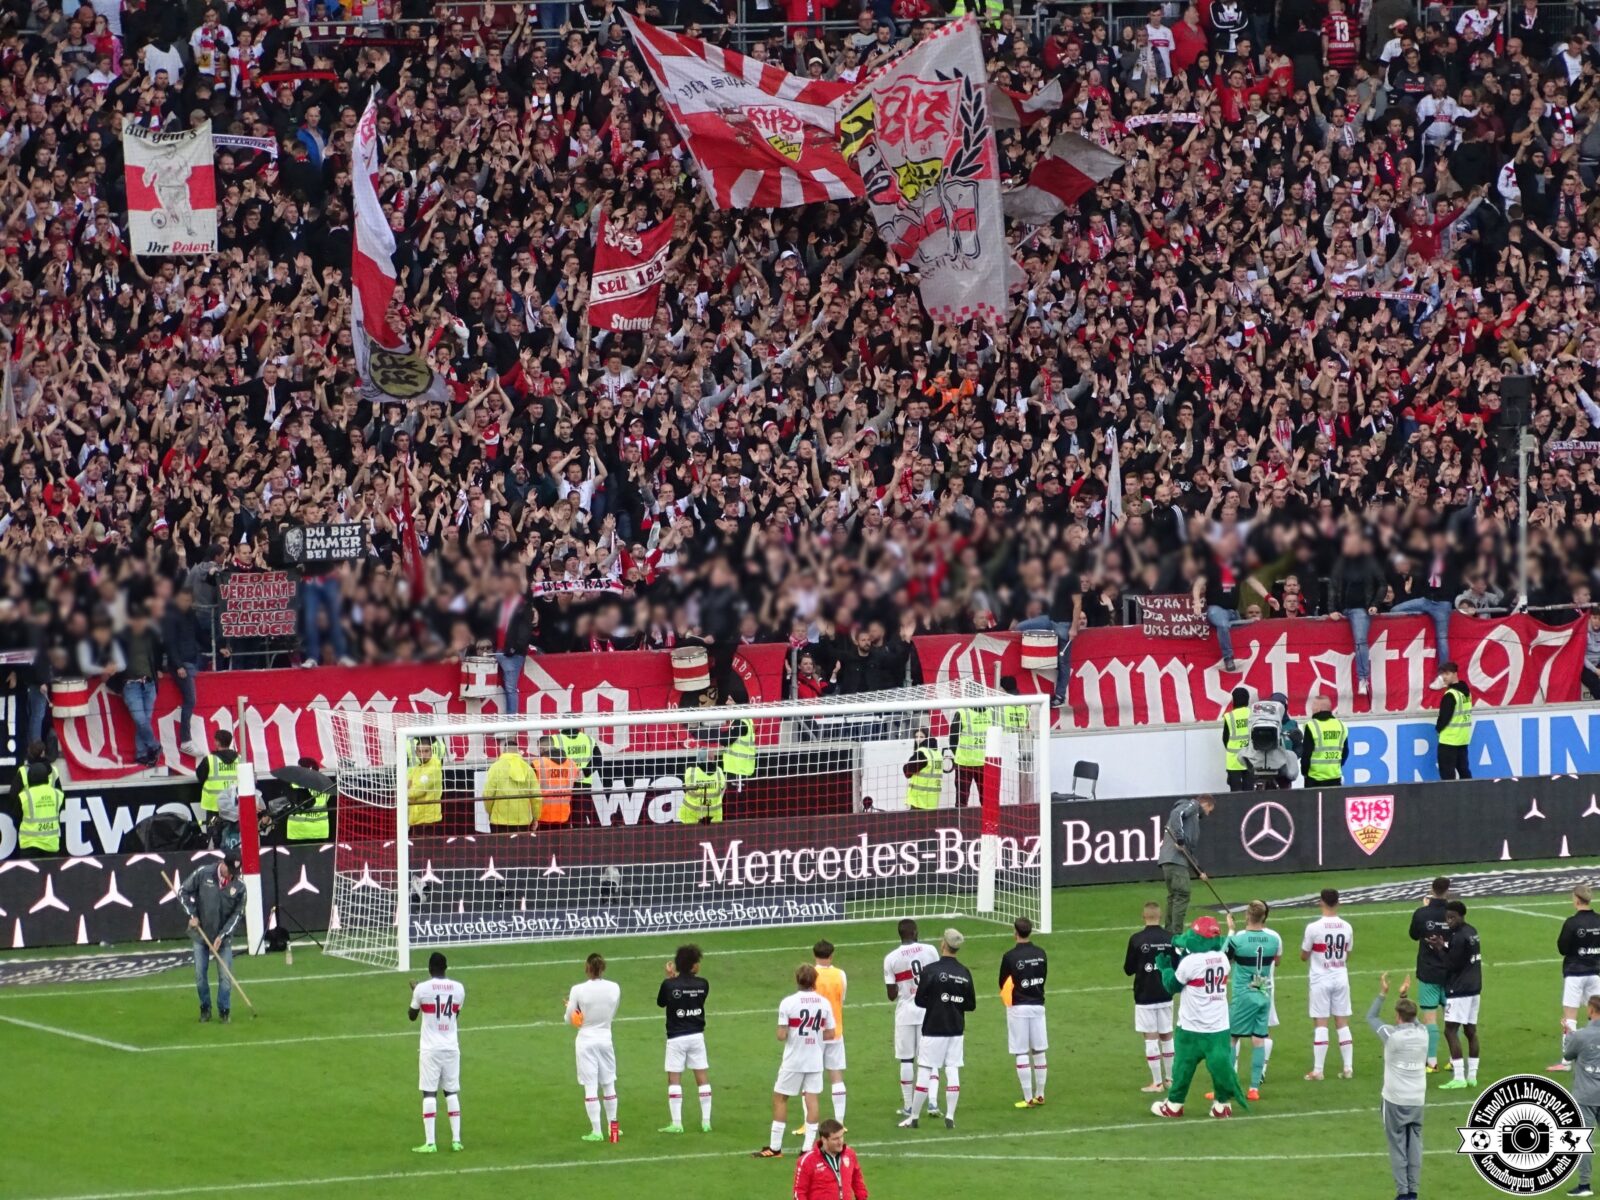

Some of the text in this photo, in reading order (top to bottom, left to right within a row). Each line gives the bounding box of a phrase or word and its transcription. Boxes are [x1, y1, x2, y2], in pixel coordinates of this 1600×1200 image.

[1335, 20, 1350, 42] 13
[147, 241, 169, 253] Ihr
[598, 275, 628, 295] seit
[306, 525, 362, 538] DU BIST
[305, 537, 361, 549] IMMER
[306, 547, 362, 559] BEI UNS!
[229, 571, 288, 585] JEDER
[220, 581, 296, 600] VERBANNTE
[227, 598, 290, 611] KEHRT
[1143, 624, 1170, 636] UMS
[1466, 624, 1574, 707] 97
[1351, 799, 1390, 823] VfB
[698, 828, 1041, 888] Mercedes-Benz
[633, 898, 837, 927] Mercedes-Benz Bank
[414, 911, 618, 937] Mercedes-Benz Bank
[1324, 933, 1345, 960] 39
[1205, 966, 1225, 994] 92
[435, 994, 453, 1020] 14
[686, 1008, 702, 1016] JAKO
[798, 1008, 822, 1036] 24
